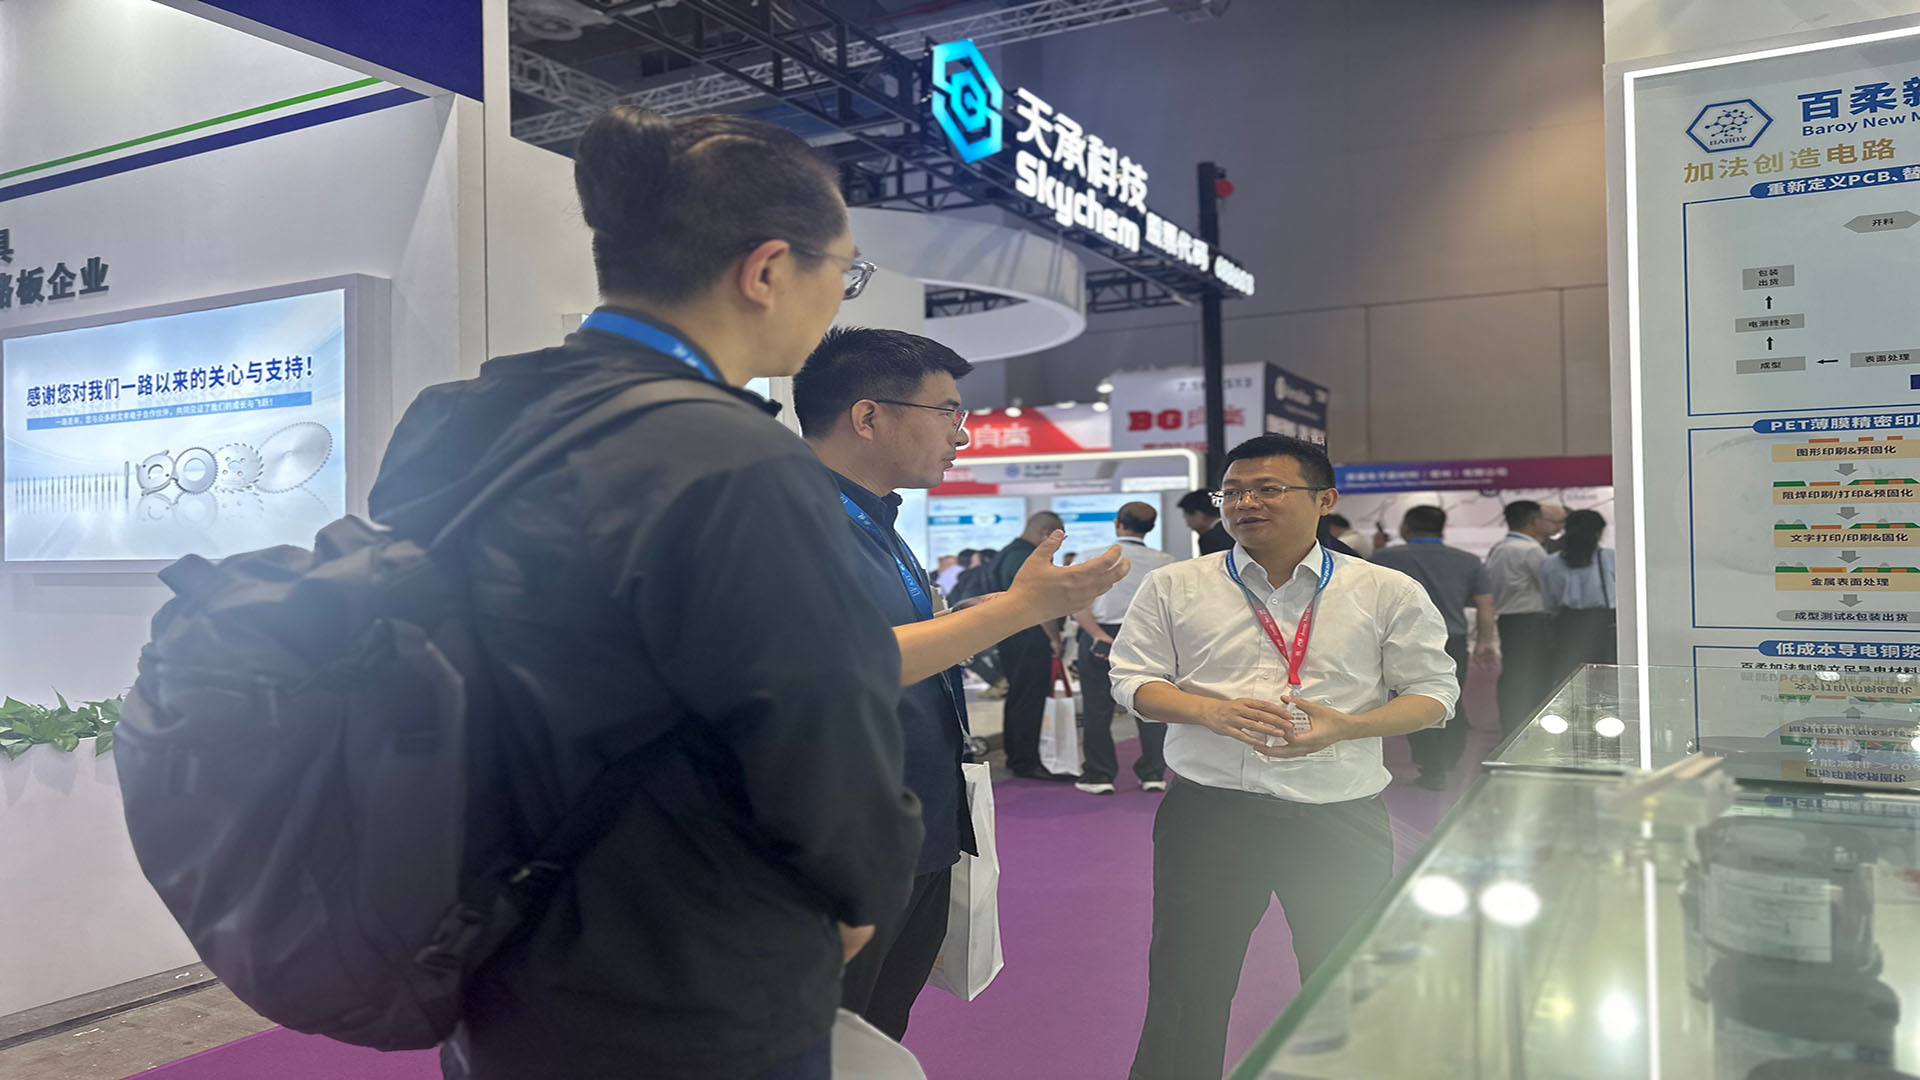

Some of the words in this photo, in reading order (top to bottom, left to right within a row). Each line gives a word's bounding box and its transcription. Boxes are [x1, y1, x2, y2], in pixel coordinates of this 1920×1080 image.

[1802, 121, 1858, 137] Baroy
[1863, 115, 1906, 129] New
[1016, 87, 1148, 213] 天承科技
[1684, 138, 1896, 184] 加法创造电路
[1015, 150, 1140, 252] Skychem
[1871, 218, 1895, 227] 开料
[1758, 268, 1779, 277] 包装
[1758, 278, 1779, 287] 出货
[1865, 353, 1910, 363] 表面处理
[1760, 361, 1782, 370] 成型
[1770, 415, 1920, 431] PET薄膜精密印
[1796, 446, 1897, 457] 图形印刷&预固化
[1782, 488, 1914, 500] 阻焊印刷/打印&预固化
[1790, 533, 1909, 543] 文字打印/印刷&固化
[1811, 577, 1890, 587] 金属表面处理
[1794, 611, 1909, 623] 成型测试&包装出货
